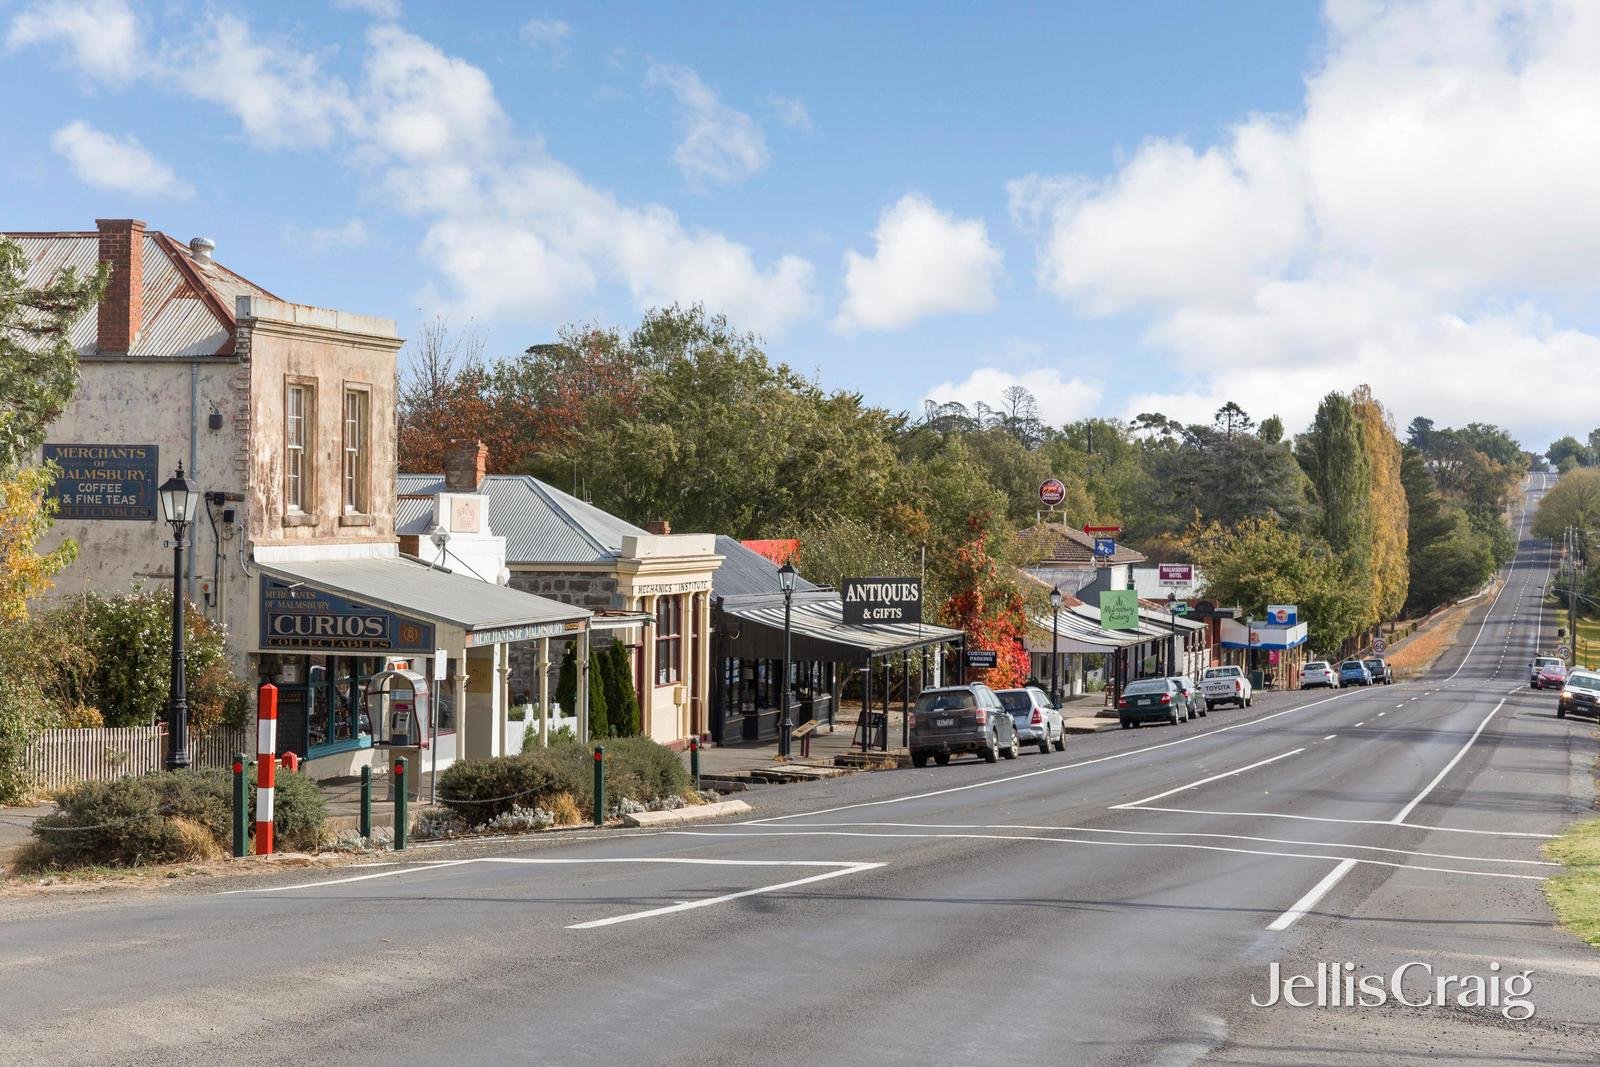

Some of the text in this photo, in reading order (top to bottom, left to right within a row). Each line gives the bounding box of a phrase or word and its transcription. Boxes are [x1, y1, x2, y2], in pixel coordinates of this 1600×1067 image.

[56, 447, 146, 459] MERCHANTS
[93, 460, 108, 468] OF
[57, 469, 148, 480] MALMSBURY
[78, 483, 122, 493] COFFEE
[63, 494, 136, 505] & FINE TEAS
[60, 506, 149, 517] OLLECTABLES
[638, 580, 708, 594] MECHANICS INSTITUTE
[265, 590, 317, 599] MERCANTS
[845, 583, 919, 605] ANTIQUES
[277, 601, 330, 610] MALMSBURY
[863, 608, 902, 619] & GIFTS
[273, 614, 384, 636] CURIOS
[267, 637, 390, 649] COLLECTABLES
